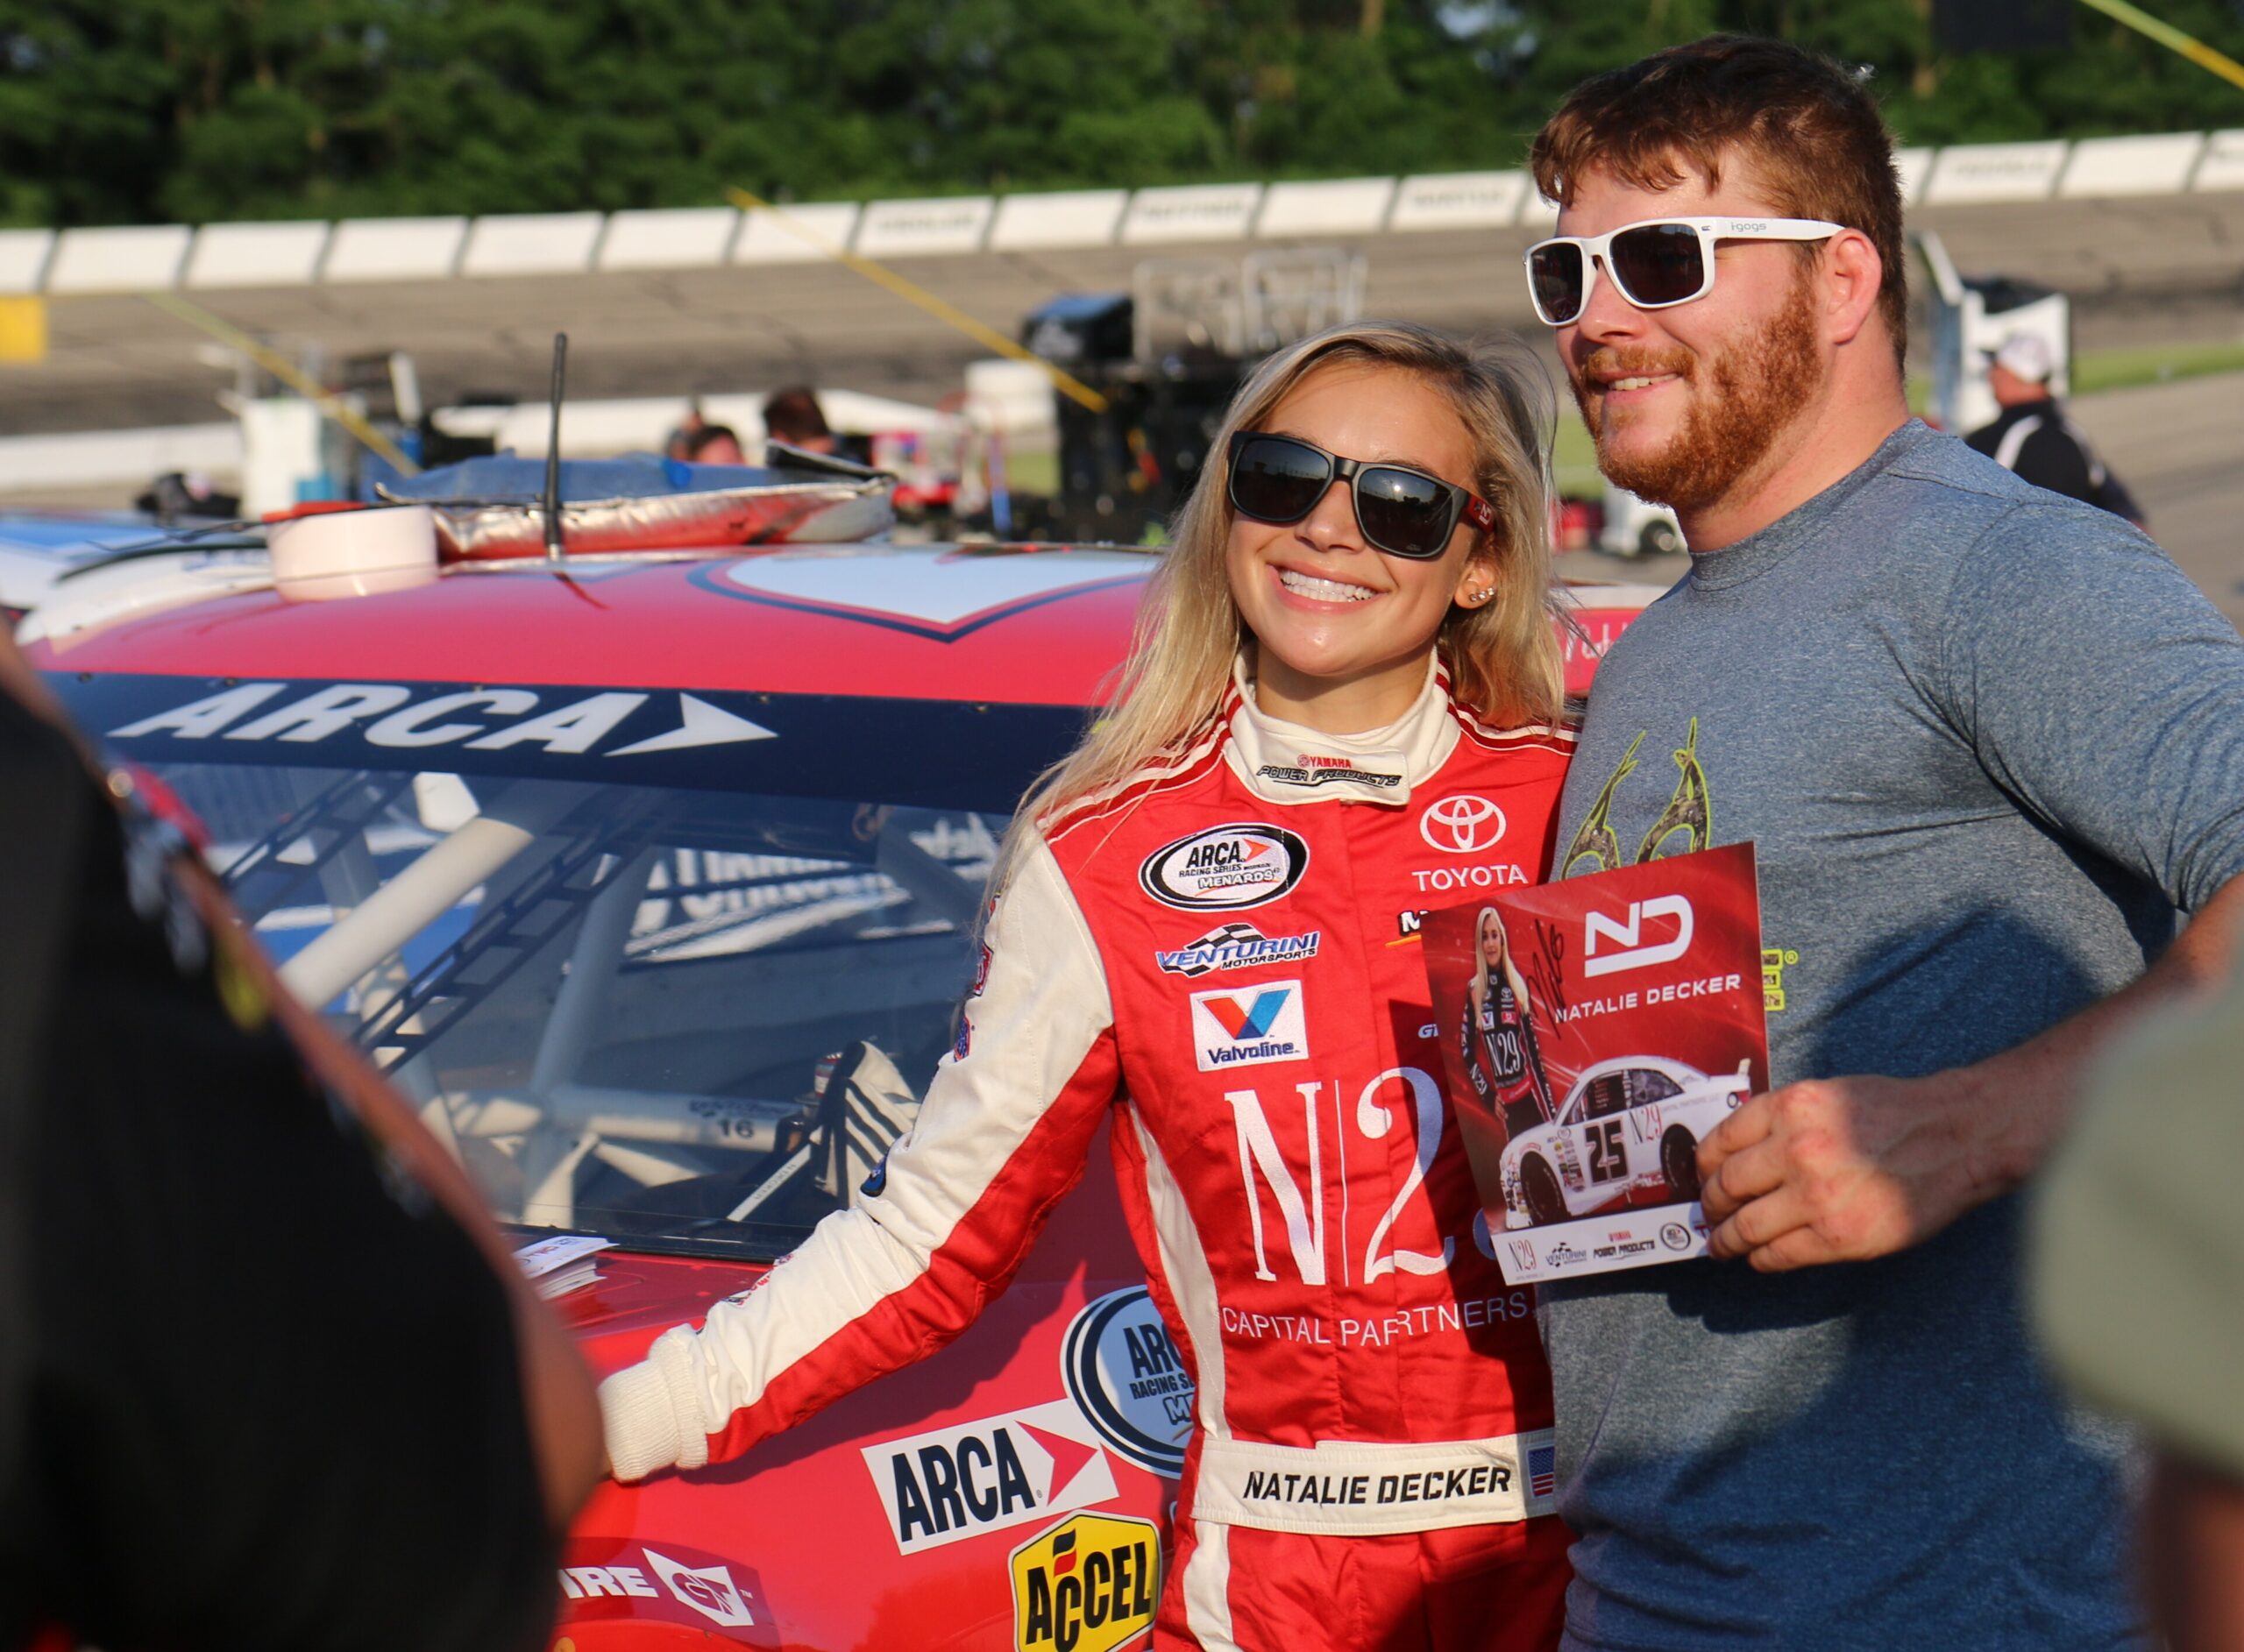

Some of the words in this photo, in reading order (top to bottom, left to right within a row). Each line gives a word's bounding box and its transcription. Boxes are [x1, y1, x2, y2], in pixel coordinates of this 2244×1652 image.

[105, 683, 650, 754] ARCA
[1256, 766, 1310, 782] POWER
[1311, 769, 1402, 787] PRODUCTS
[1309, 756, 1352, 769] YAMAHA
[1186, 840, 1242, 869] ARCA
[1178, 867, 1211, 878] RACING
[1212, 864, 1242, 875] SERIES
[1198, 869, 1275, 890] MENARDS
[1411, 864, 1529, 892] TOYOTA
[1157, 932, 1319, 967] VENTURINI
[1222, 947, 1316, 970] MOTORSPORTS
[1554, 992, 1638, 1025] NATALIE
[1646, 973, 1742, 1006] DECKER
[1208, 1041, 1295, 1065] Valvoline
[717, 1118, 755, 1138] 16
[1585, 1119, 1629, 1184] 25
[1223, 1306, 1331, 1345] CAPITAL
[1339, 1292, 1529, 1347] PARTNERS
[1129, 1374, 1179, 1400] RACING
[891, 1427, 1037, 1543] ARCA
[1243, 1470, 1370, 1505] NATALIE
[1376, 1465, 1512, 1505] DECKER
[557, 1566, 659, 1599] IRE
[1026, 1541, 1151, 1652] ACCEL
